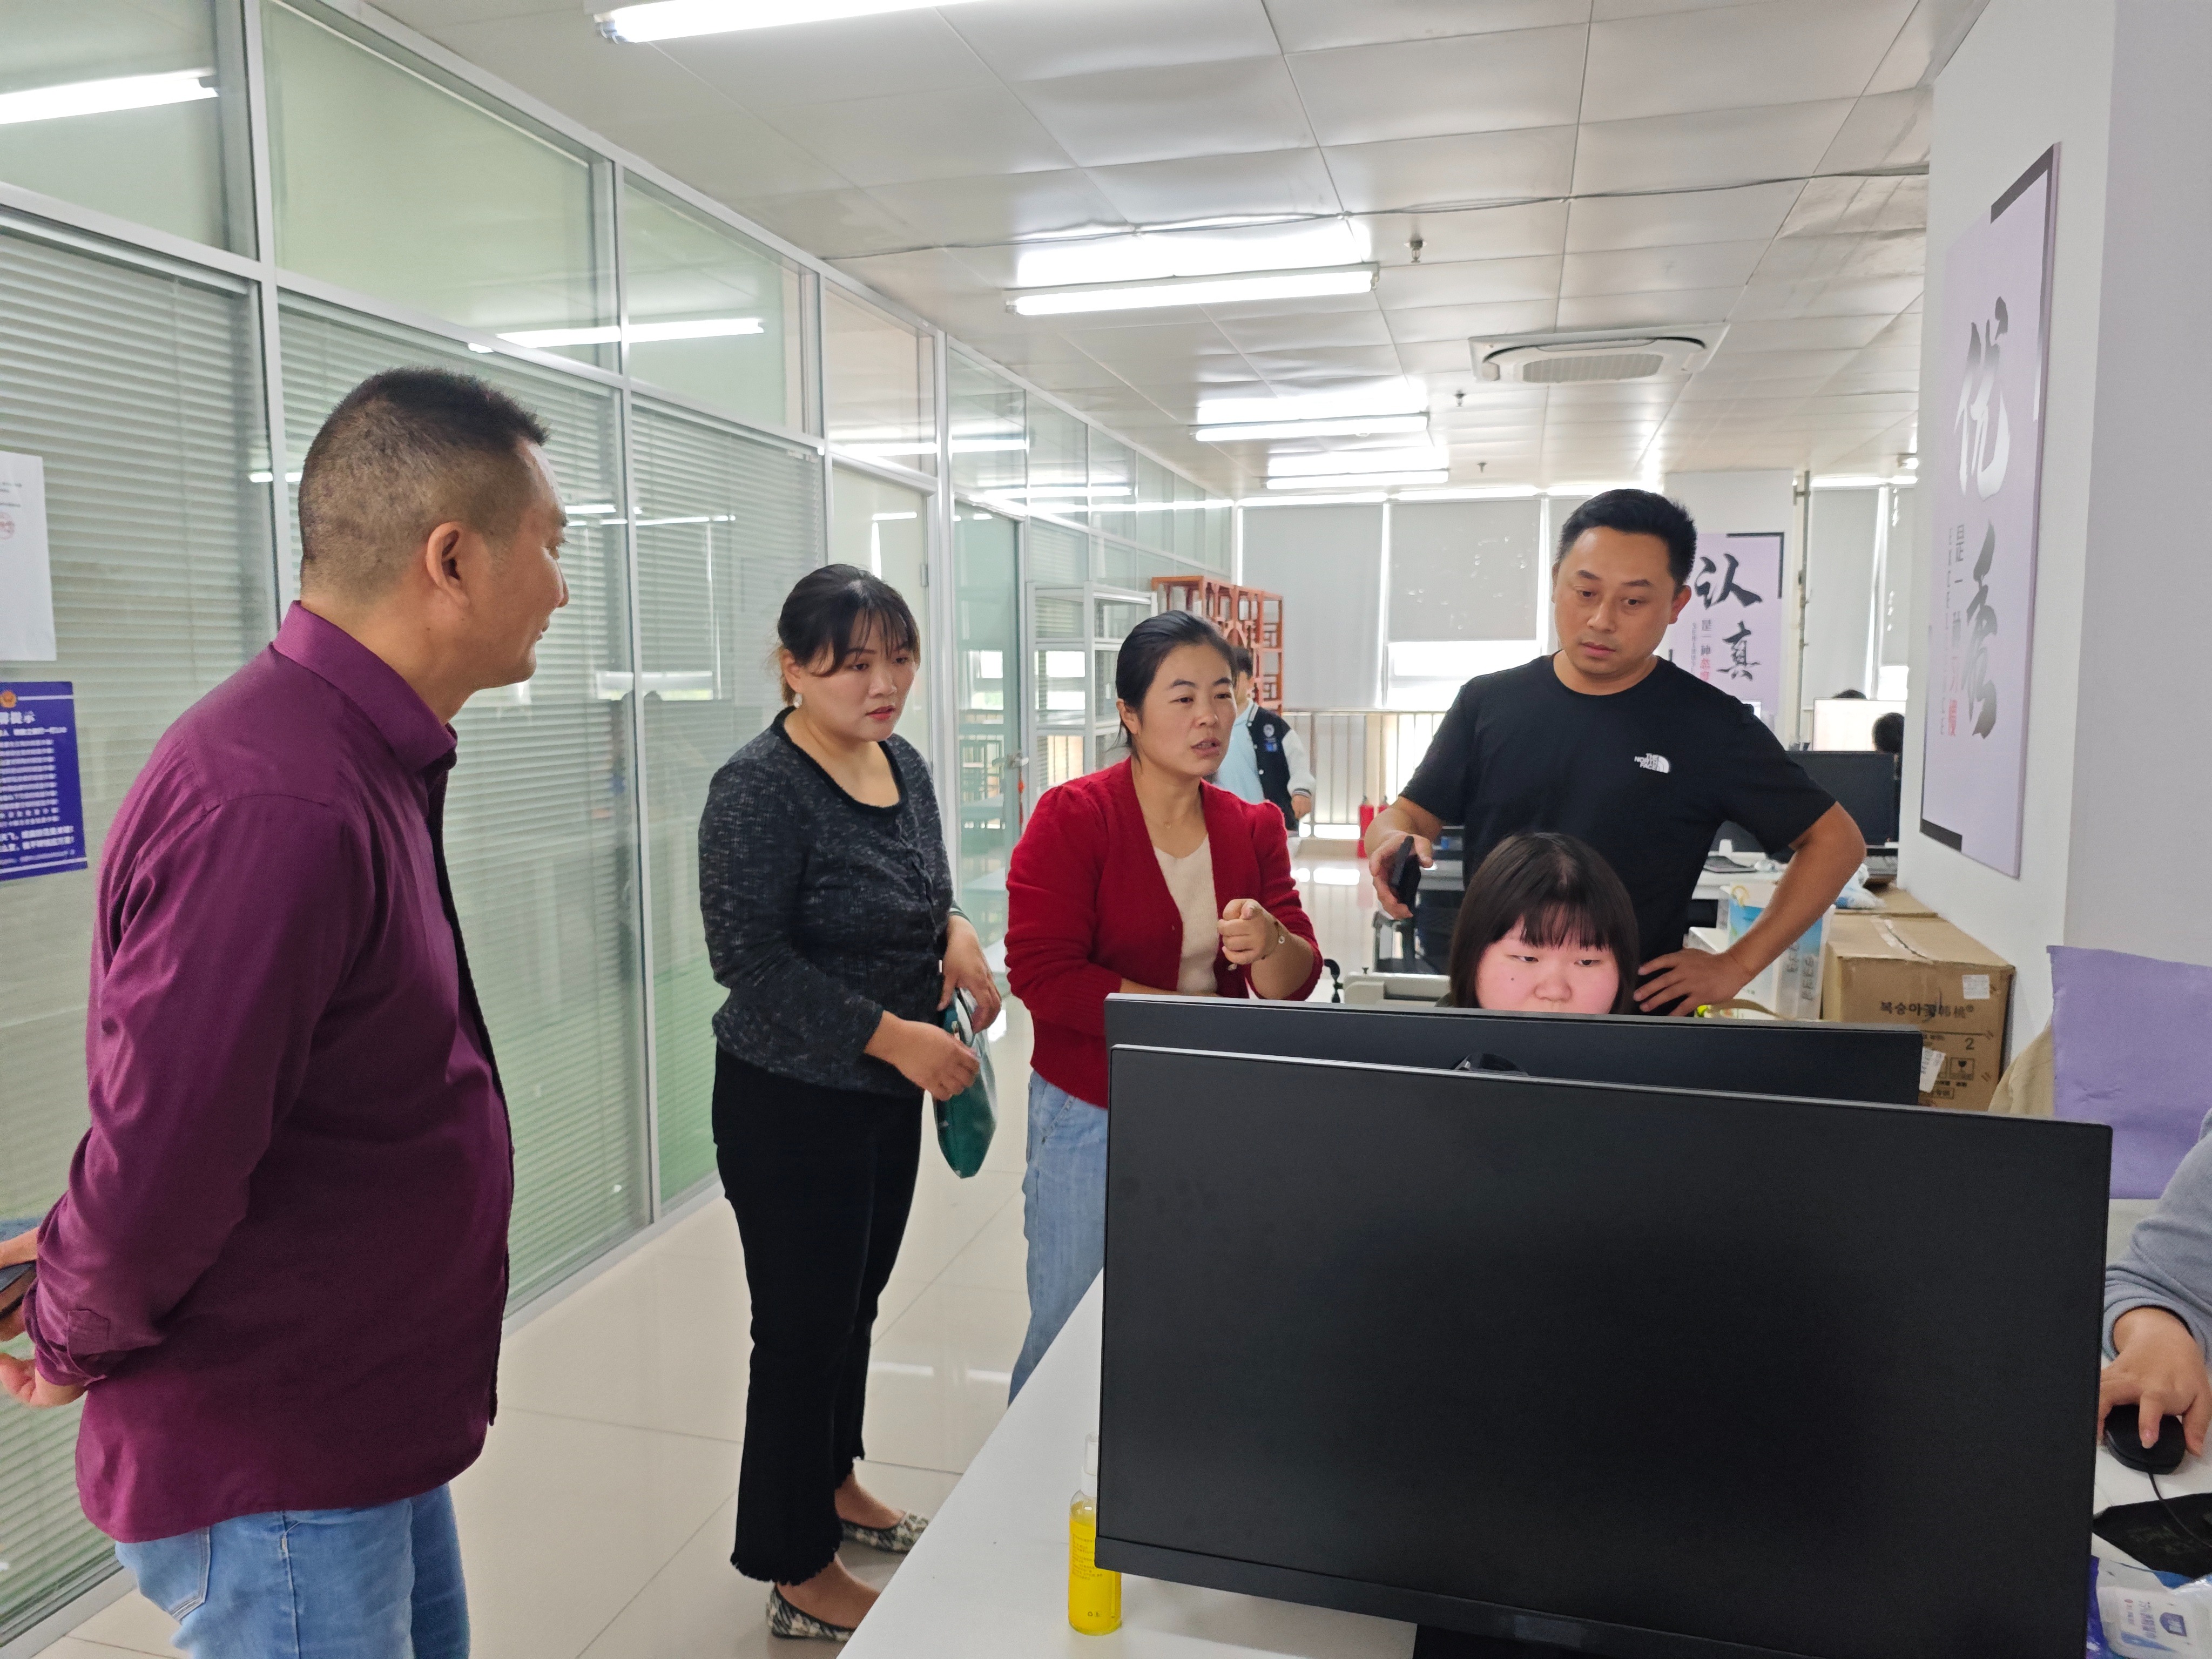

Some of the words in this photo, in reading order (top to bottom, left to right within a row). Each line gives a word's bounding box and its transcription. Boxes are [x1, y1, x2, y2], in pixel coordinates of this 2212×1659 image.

[1953, 296, 2010, 740] 优秀
[1695, 554, 1763, 681] 认真
[1634, 756, 1658, 766] NORTH
[1640, 761, 1657, 771] FACE
[1965, 1037, 1974, 1050] 2
